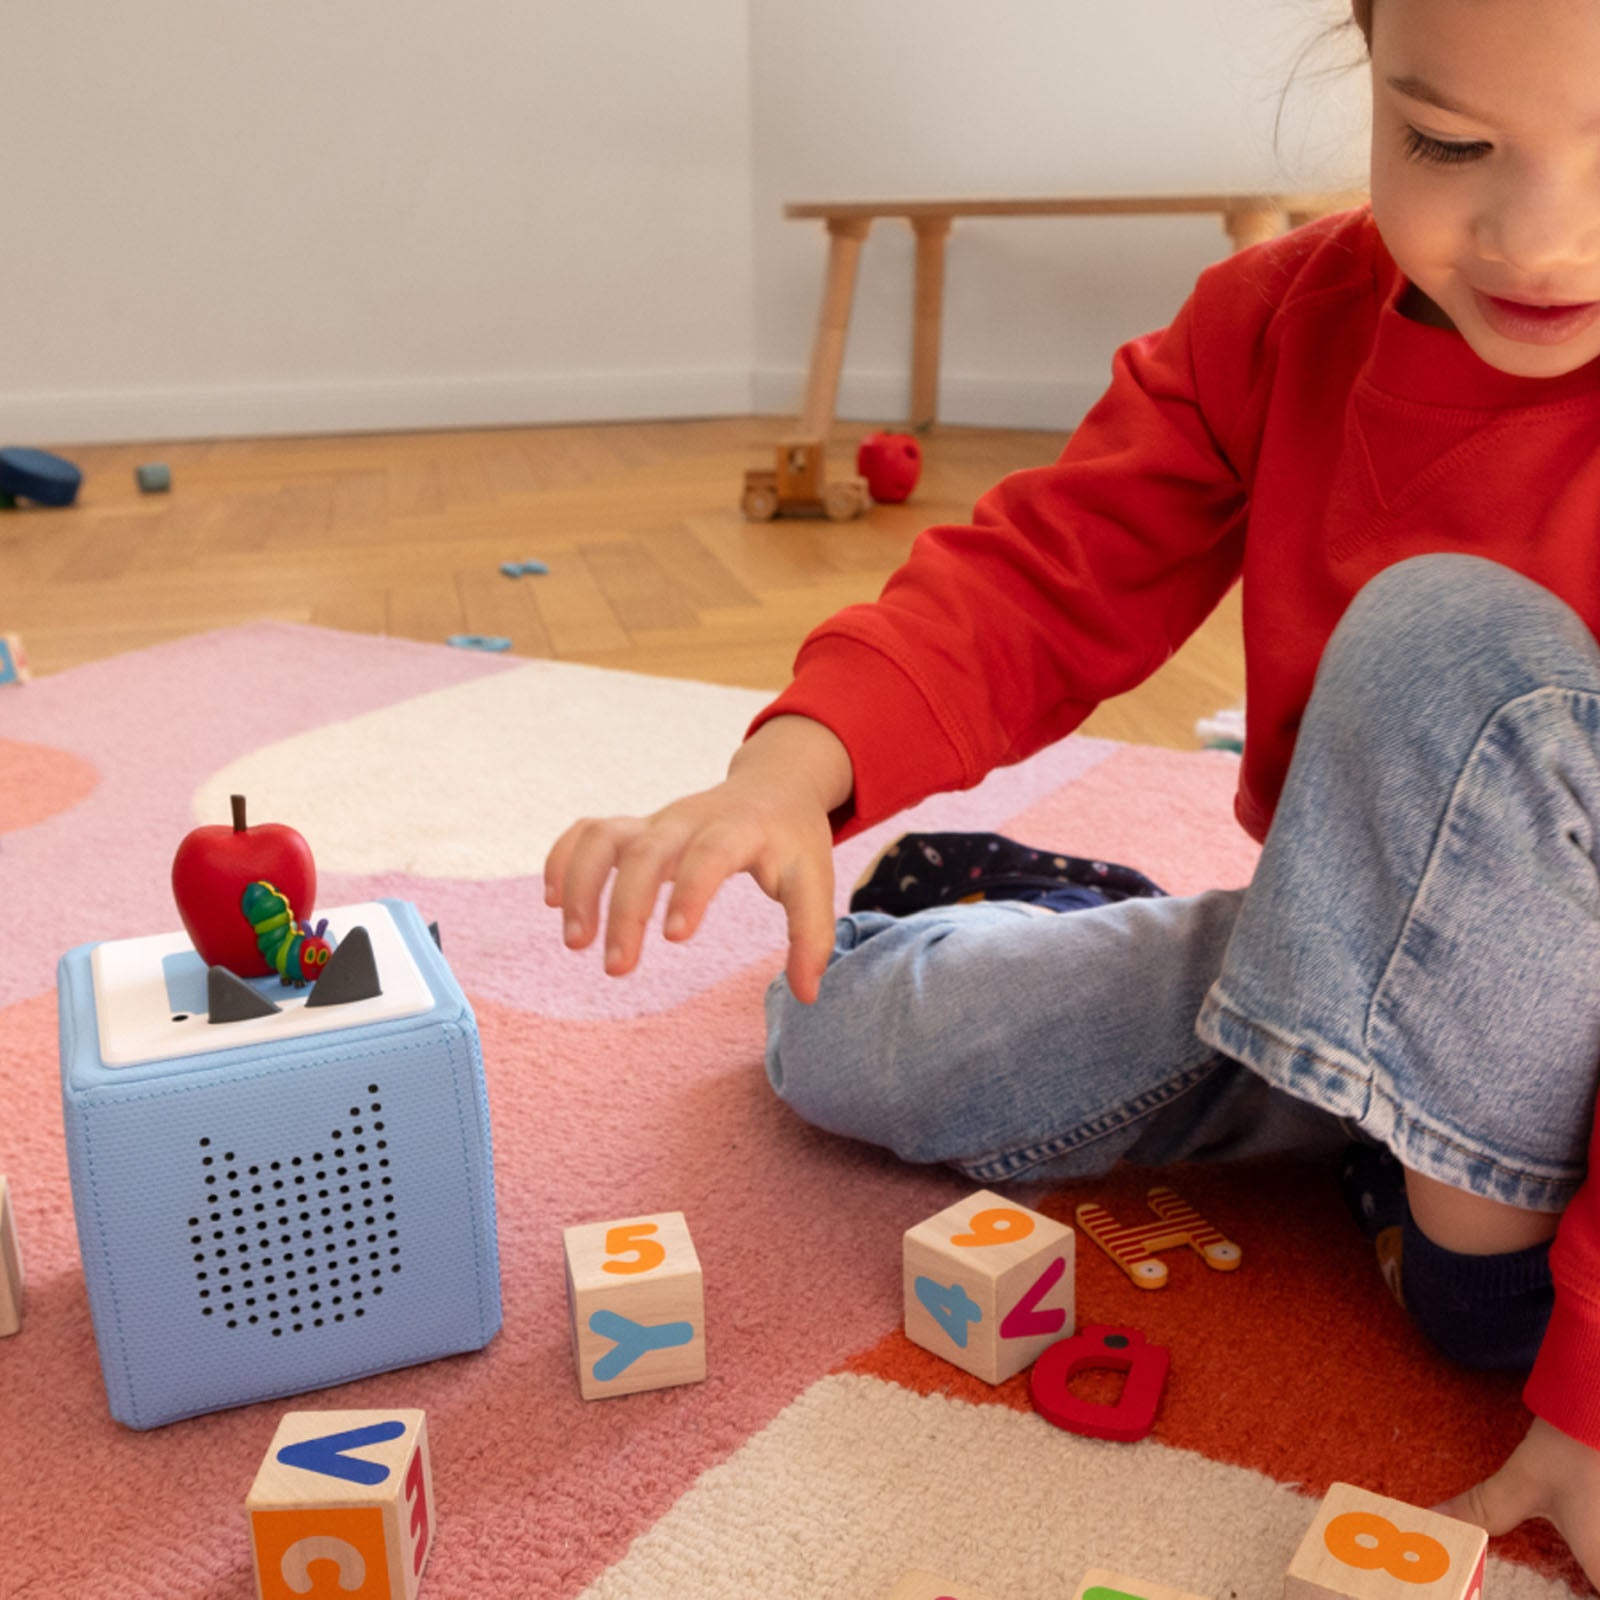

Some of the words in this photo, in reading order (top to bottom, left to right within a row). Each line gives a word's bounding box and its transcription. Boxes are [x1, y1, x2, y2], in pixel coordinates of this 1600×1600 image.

[602, 1223, 666, 1275] 5
[589, 1309, 694, 1382] Y
[914, 1275, 983, 1349] 4
[276, 1421, 406, 1486] V
[280, 1535, 366, 1594] C
[1323, 1511, 1451, 1584] 8
